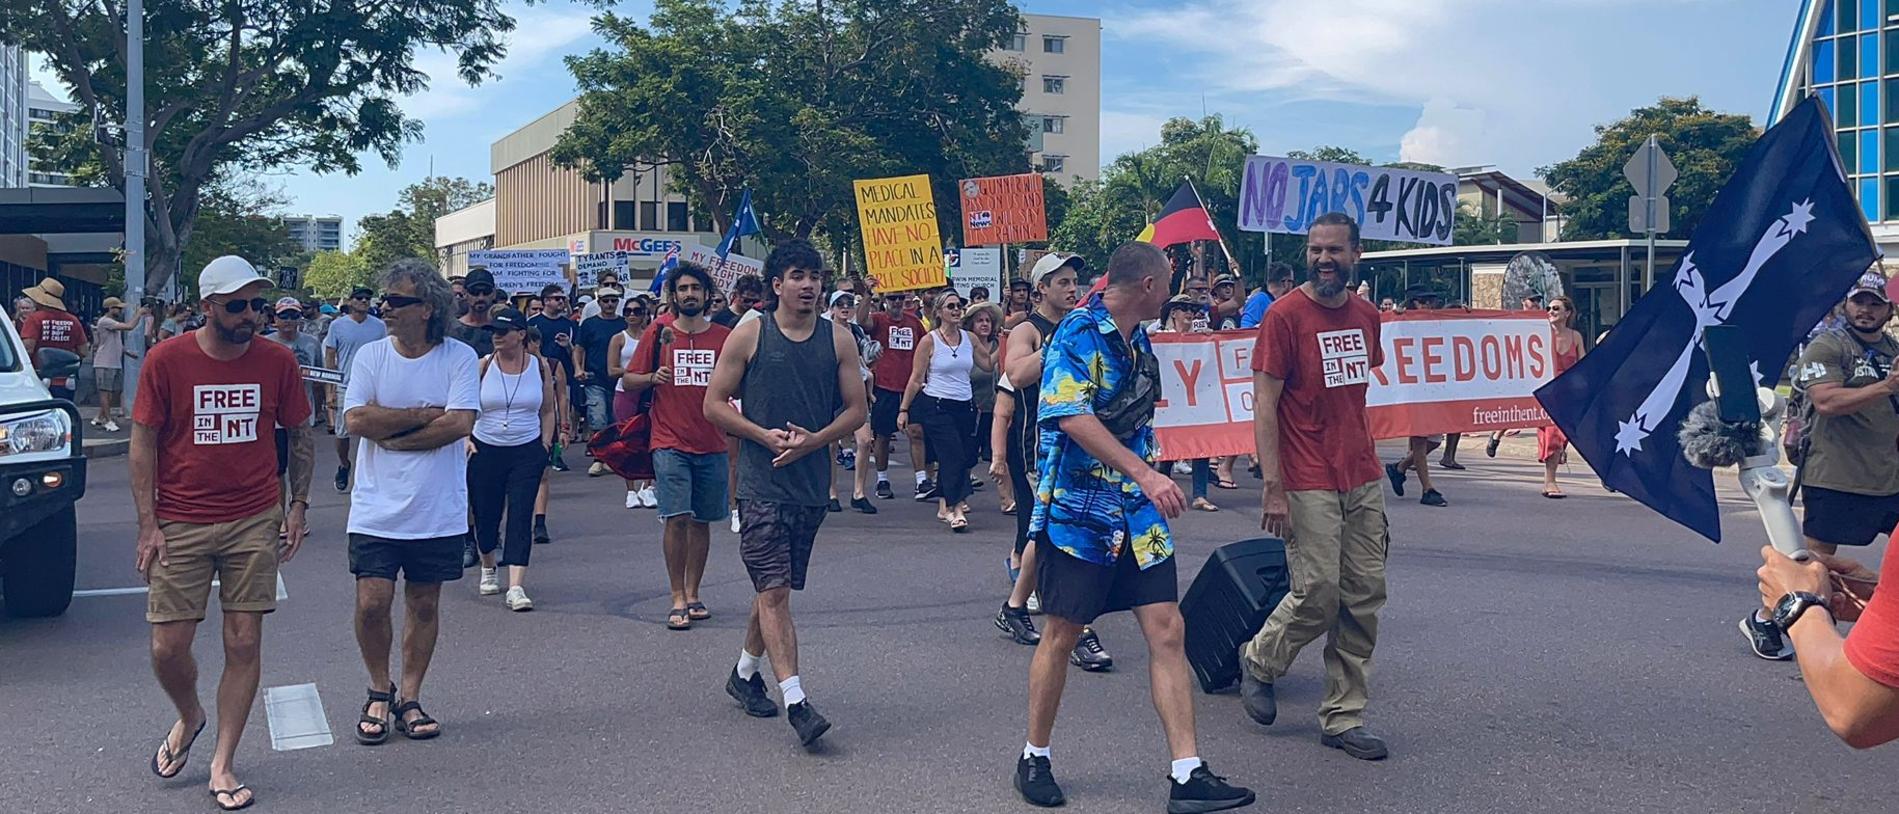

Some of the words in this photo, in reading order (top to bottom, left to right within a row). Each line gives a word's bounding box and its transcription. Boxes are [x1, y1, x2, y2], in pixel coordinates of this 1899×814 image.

[861, 183, 920, 203] MEDICAL
[987, 196, 1002, 209] ON
[1007, 194, 1020, 208] US
[1023, 192, 1041, 207] AND
[1243, 161, 1288, 229] NO
[1284, 165, 1369, 231] JABS
[1367, 173, 1393, 223] 4
[1395, 177, 1456, 241] KIDS
[865, 202, 935, 224] MANDATES
[969, 212, 981, 220] NT
[1018, 208, 1039, 222] SAY
[970, 220, 991, 228] News
[866, 227, 898, 246] HAVE
[905, 223, 930, 241] NO
[577, 251, 615, 263] TYRANTS
[691, 251, 706, 262] MY
[710, 256, 758, 275] FREEDOM
[869, 249, 904, 269] PLACE
[910, 247, 924, 264] IN
[929, 246, 941, 263] A
[577, 261, 608, 270] DEMAND
[707, 265, 742, 280] RIGHT
[875, 271, 894, 288] REE
[901, 266, 944, 287] SOCIETY
[891, 327, 912, 337] FREE
[900, 340, 912, 348] NT
[1323, 334, 1362, 354] FREE
[677, 353, 712, 364] FREE
[1371, 334, 1545, 386] EEDOMS
[1326, 362, 1336, 371] IN
[1346, 361, 1365, 379] NT
[694, 371, 710, 382] NT
[1328, 376, 1343, 385] THE
[200, 389, 255, 409] FREE
[197, 418, 212, 427] IN
[227, 418, 254, 438] NT
[197, 432, 218, 442] THE
